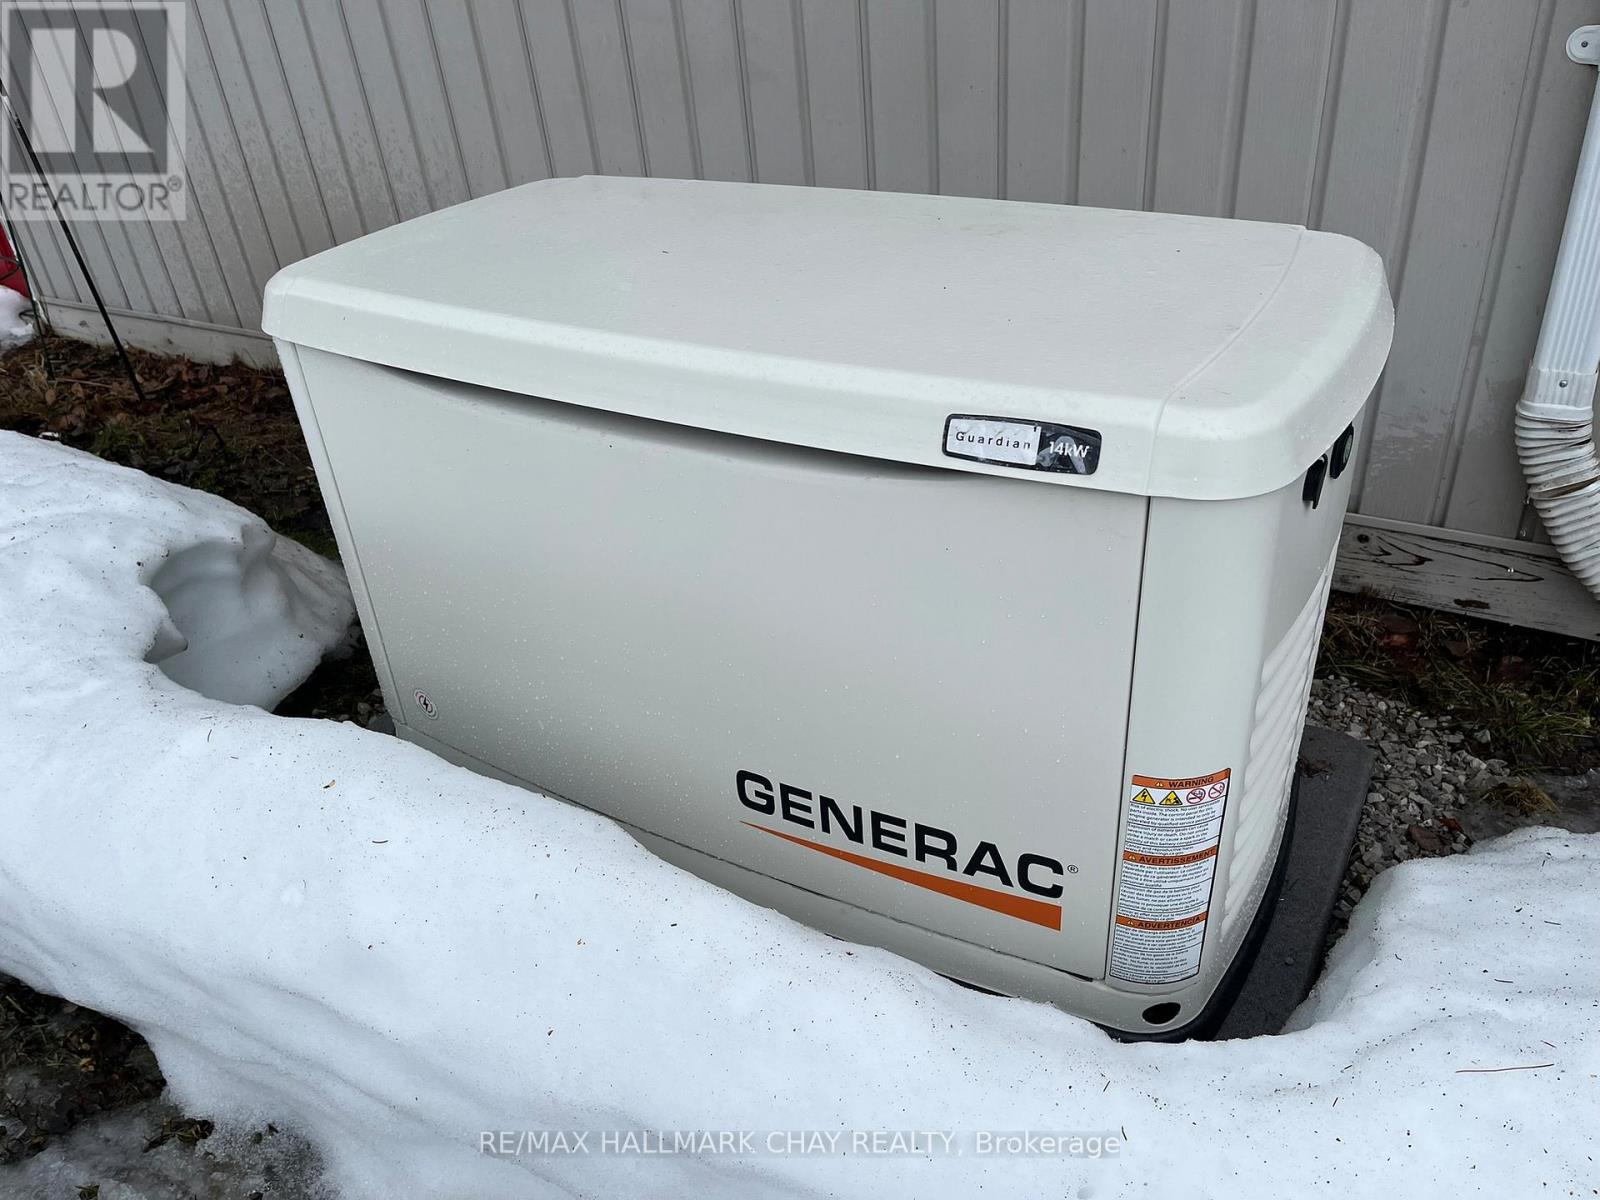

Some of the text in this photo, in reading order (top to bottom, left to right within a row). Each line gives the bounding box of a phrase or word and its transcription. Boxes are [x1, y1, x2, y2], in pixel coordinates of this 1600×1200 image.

[956, 431, 1090, 458] Guardian 14kW
[1168, 776, 1214, 788] WARNING
[1140, 849, 1213, 864] AVERTISSEMENT
[1138, 916, 1201, 929] ADVERTENCIA
